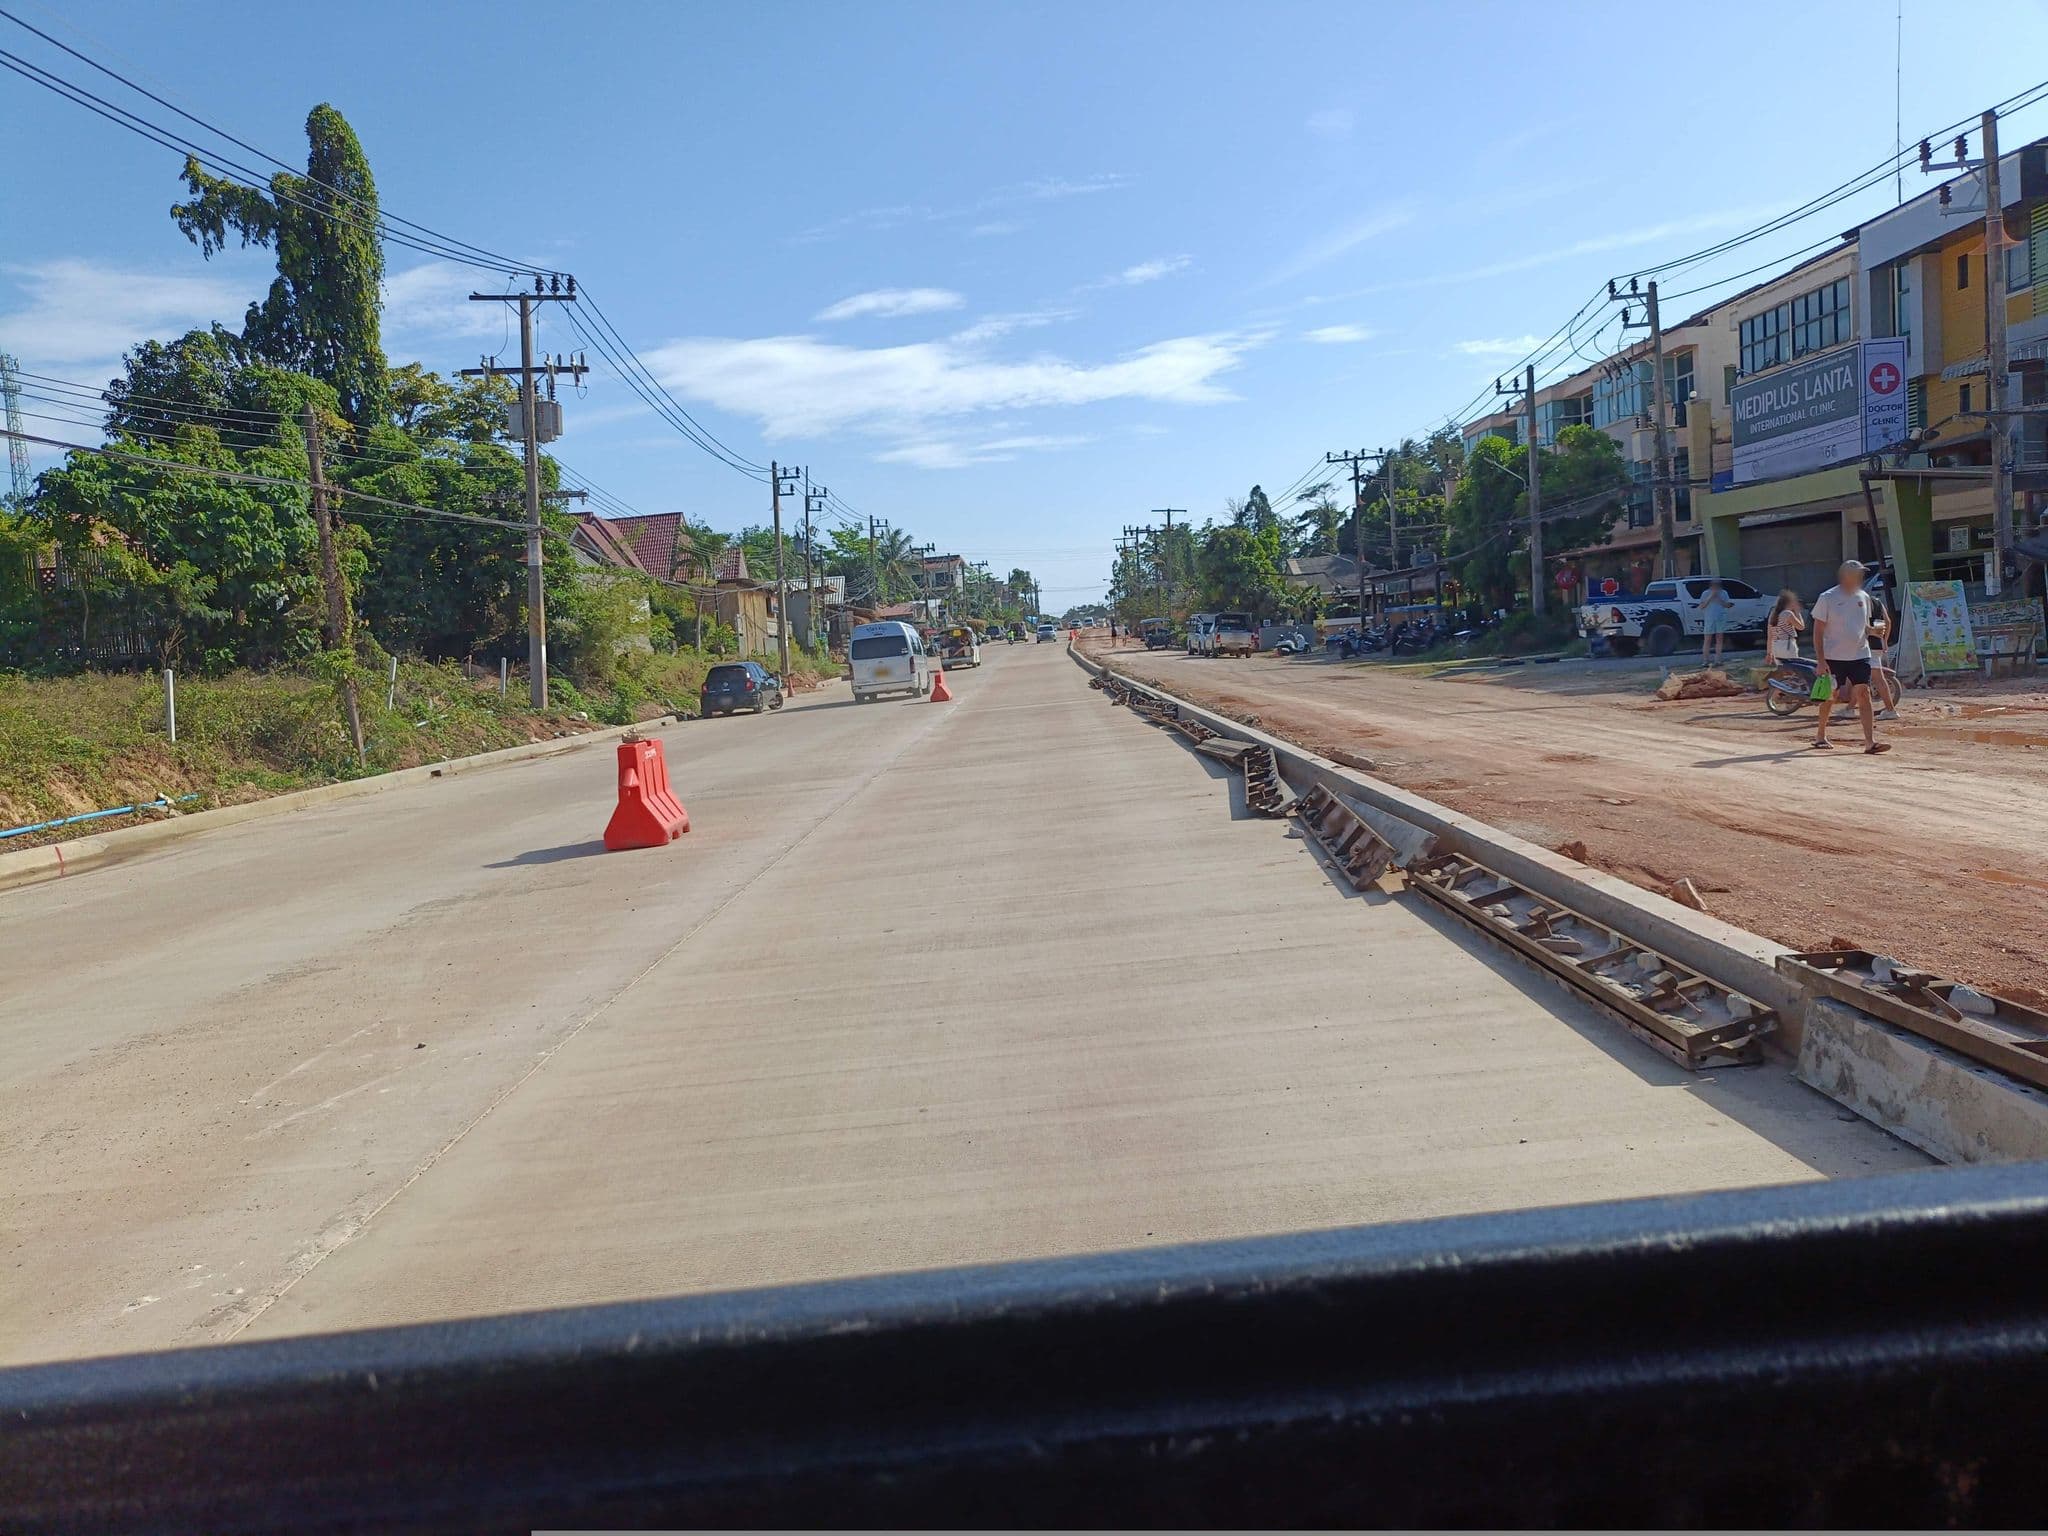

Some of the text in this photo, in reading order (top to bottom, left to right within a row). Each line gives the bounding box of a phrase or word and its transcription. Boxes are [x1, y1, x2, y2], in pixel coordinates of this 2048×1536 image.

[1736, 366, 1853, 421] MEDIPLUS LANTA
[1750, 400, 1836, 434] INTERNATIONAL CLINIC
[1868, 403, 1903, 413] DOCTOR
[1872, 416, 1900, 425] CLINIC
